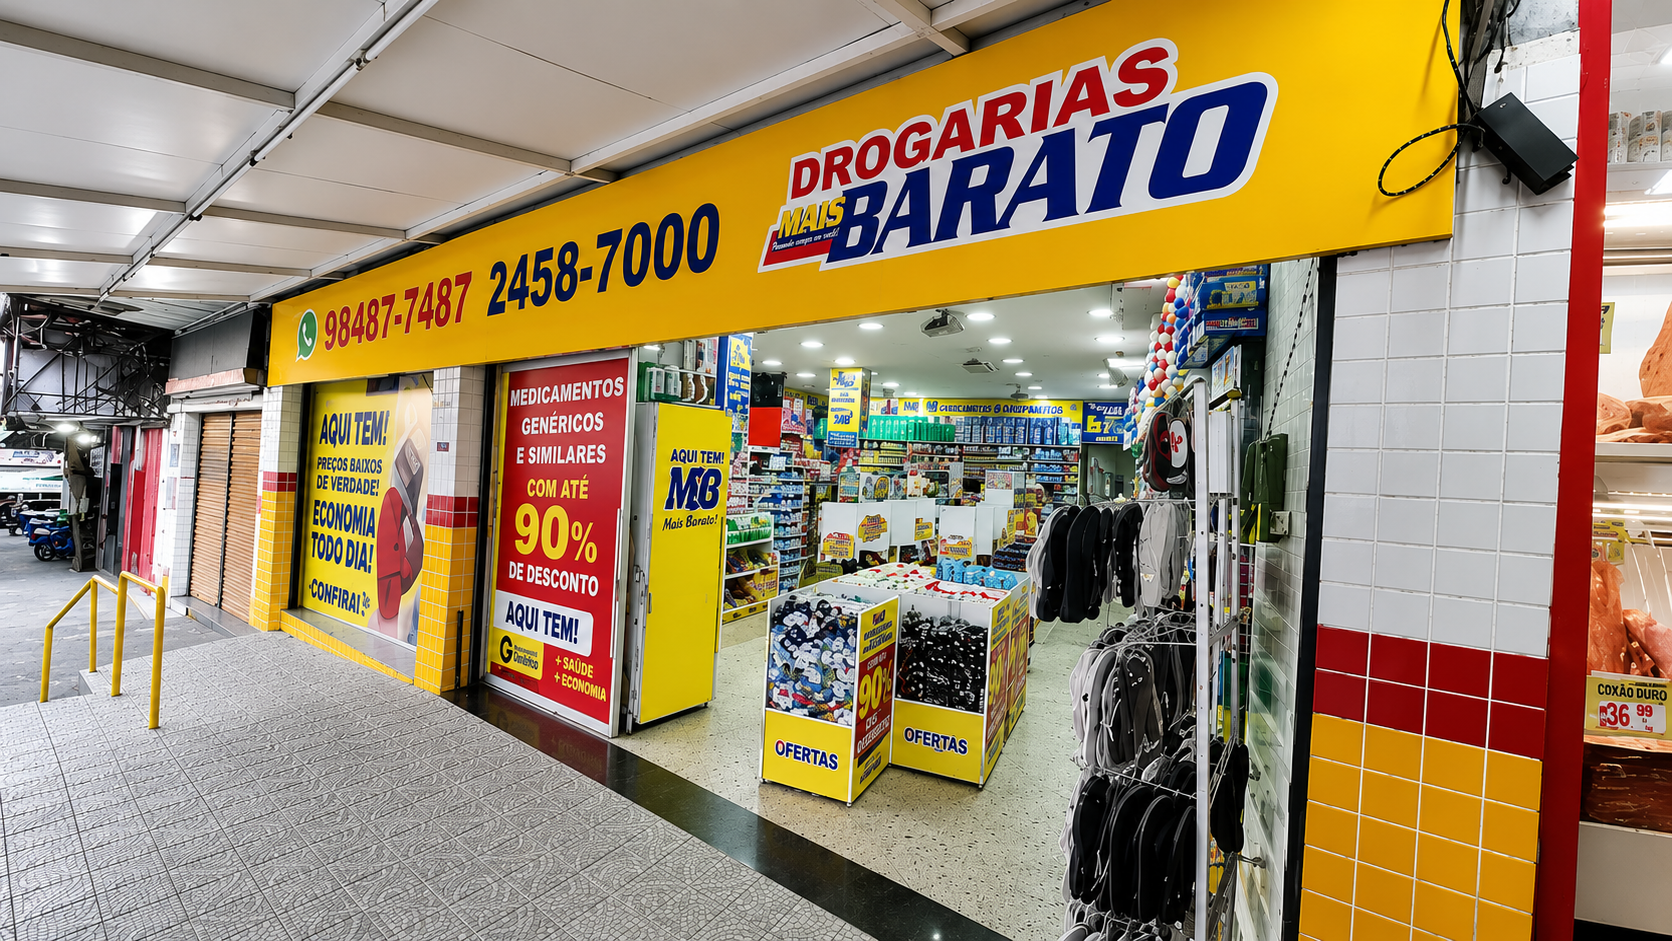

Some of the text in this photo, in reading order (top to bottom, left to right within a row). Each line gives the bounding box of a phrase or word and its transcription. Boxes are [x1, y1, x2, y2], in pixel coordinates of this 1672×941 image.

[791, 46, 1170, 200] DROGARIAS
[825, 81, 1268, 263] BARATO
[778, 197, 846, 239] MAIS
[324, 203, 720, 351] 98487-7487 2458-7000
[510, 376, 624, 407] MEDICAMENTOS
[319, 410, 390, 448] AQUI TEM!
[521, 410, 604, 435] GENÉRICOS
[317, 456, 383, 474] PREÇOS BAIXOS
[516, 444, 606, 464] E SIMILARES
[670, 448, 725, 464] AQUI TEM!
[316, 475, 380, 497] DE VERDADE!
[527, 474, 589, 500] COM ATÉ
[313, 500, 375, 539] ECONOMIA
[515, 503, 598, 563] 90%
[662, 514, 718, 531] Mais Barato!
[311, 531, 374, 574] TODO DIA!
[509, 561, 599, 597] DE DESCONTO
[505, 600, 579, 644] AQUI TEM!
[561, 673, 607, 702] ECONOMIA
[1597, 683, 1634, 698] COXÃO
[1636, 687, 1668, 701] DURO
[1636, 704, 1654, 717] 99
[774, 740, 839, 771] OFERTAS
[904, 727, 968, 756] OFERTAS
